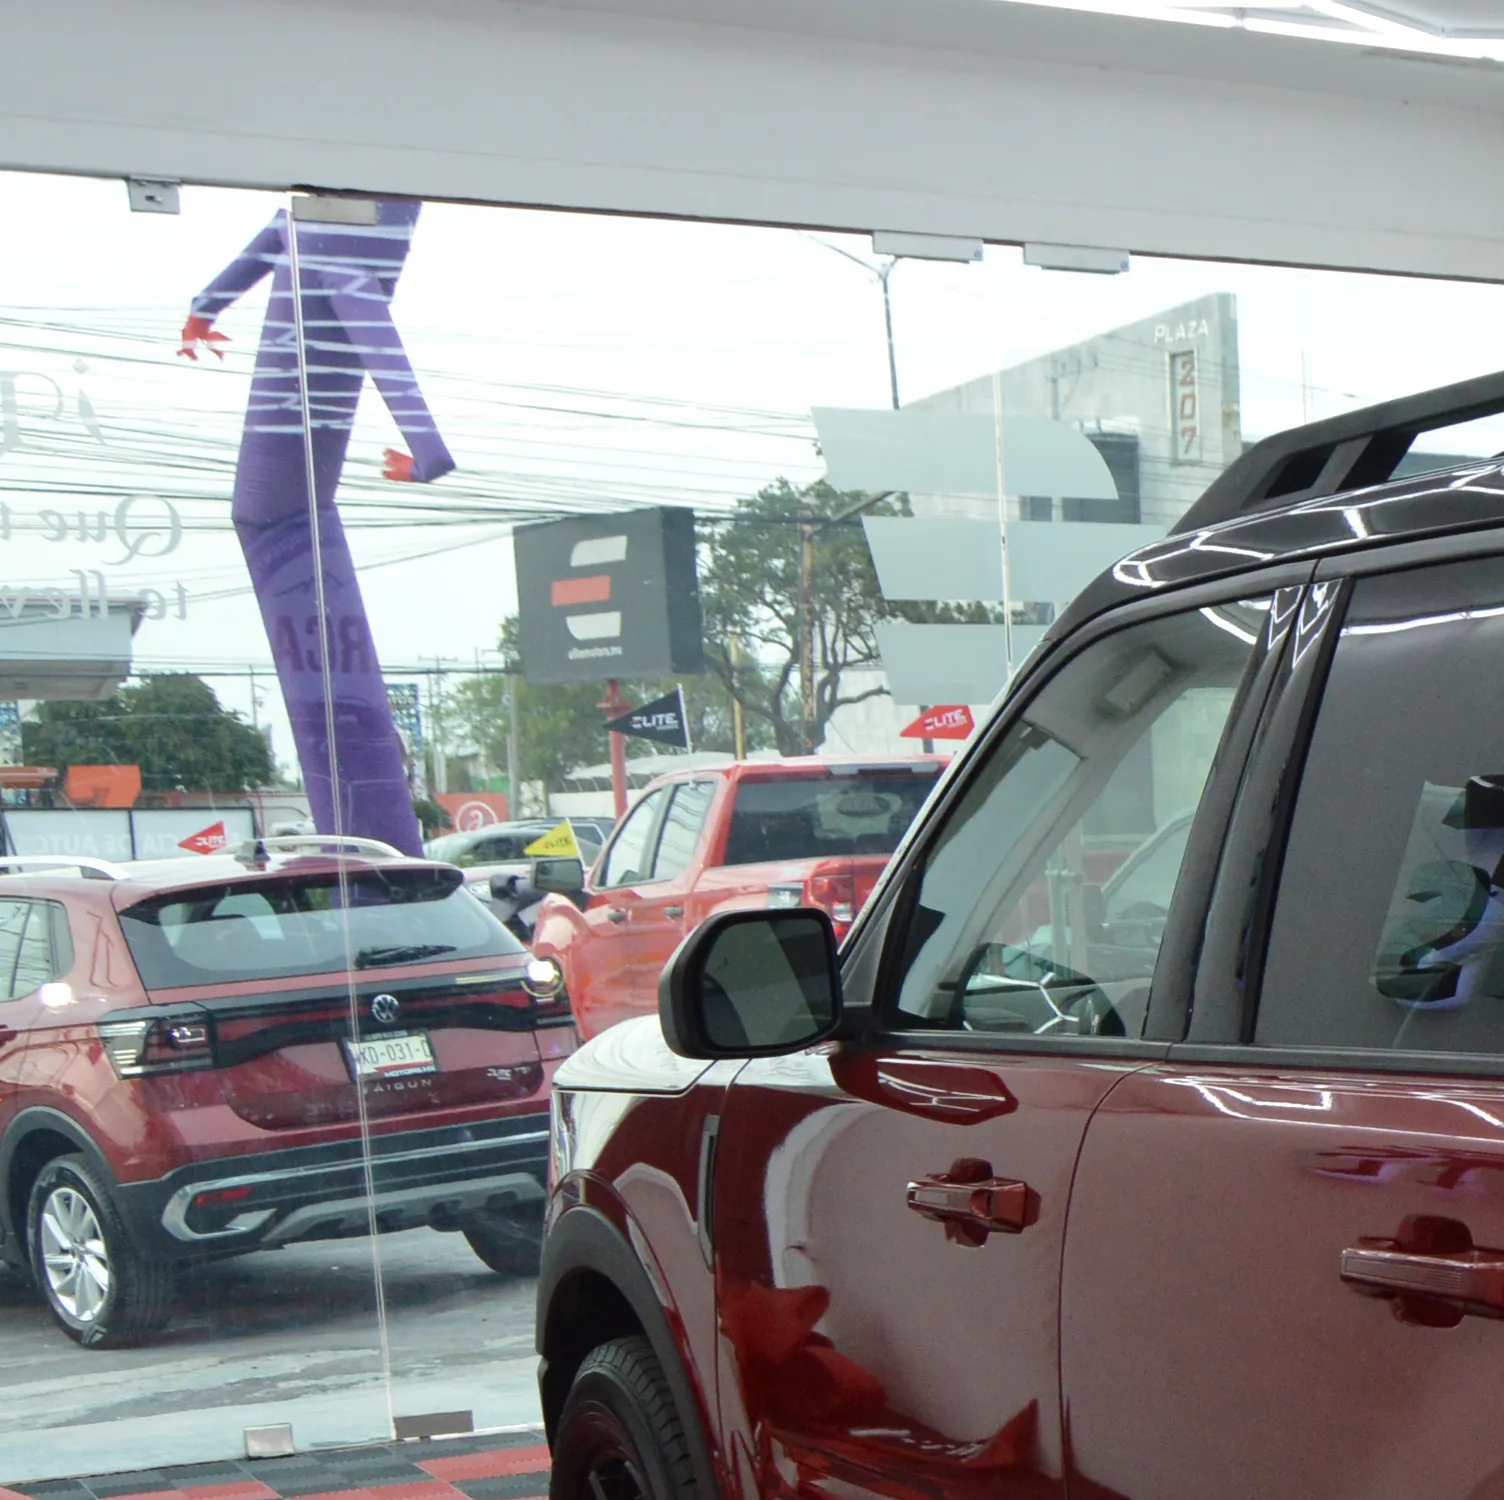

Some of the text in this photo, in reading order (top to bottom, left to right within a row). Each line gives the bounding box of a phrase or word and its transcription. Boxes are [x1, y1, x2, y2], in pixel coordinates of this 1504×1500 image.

[1153, 318, 1209, 345] PLAZA
[1178, 356, 1197, 455] 207
[630, 712, 678, 729] ELITE
[924, 708, 967, 731] ELITE
